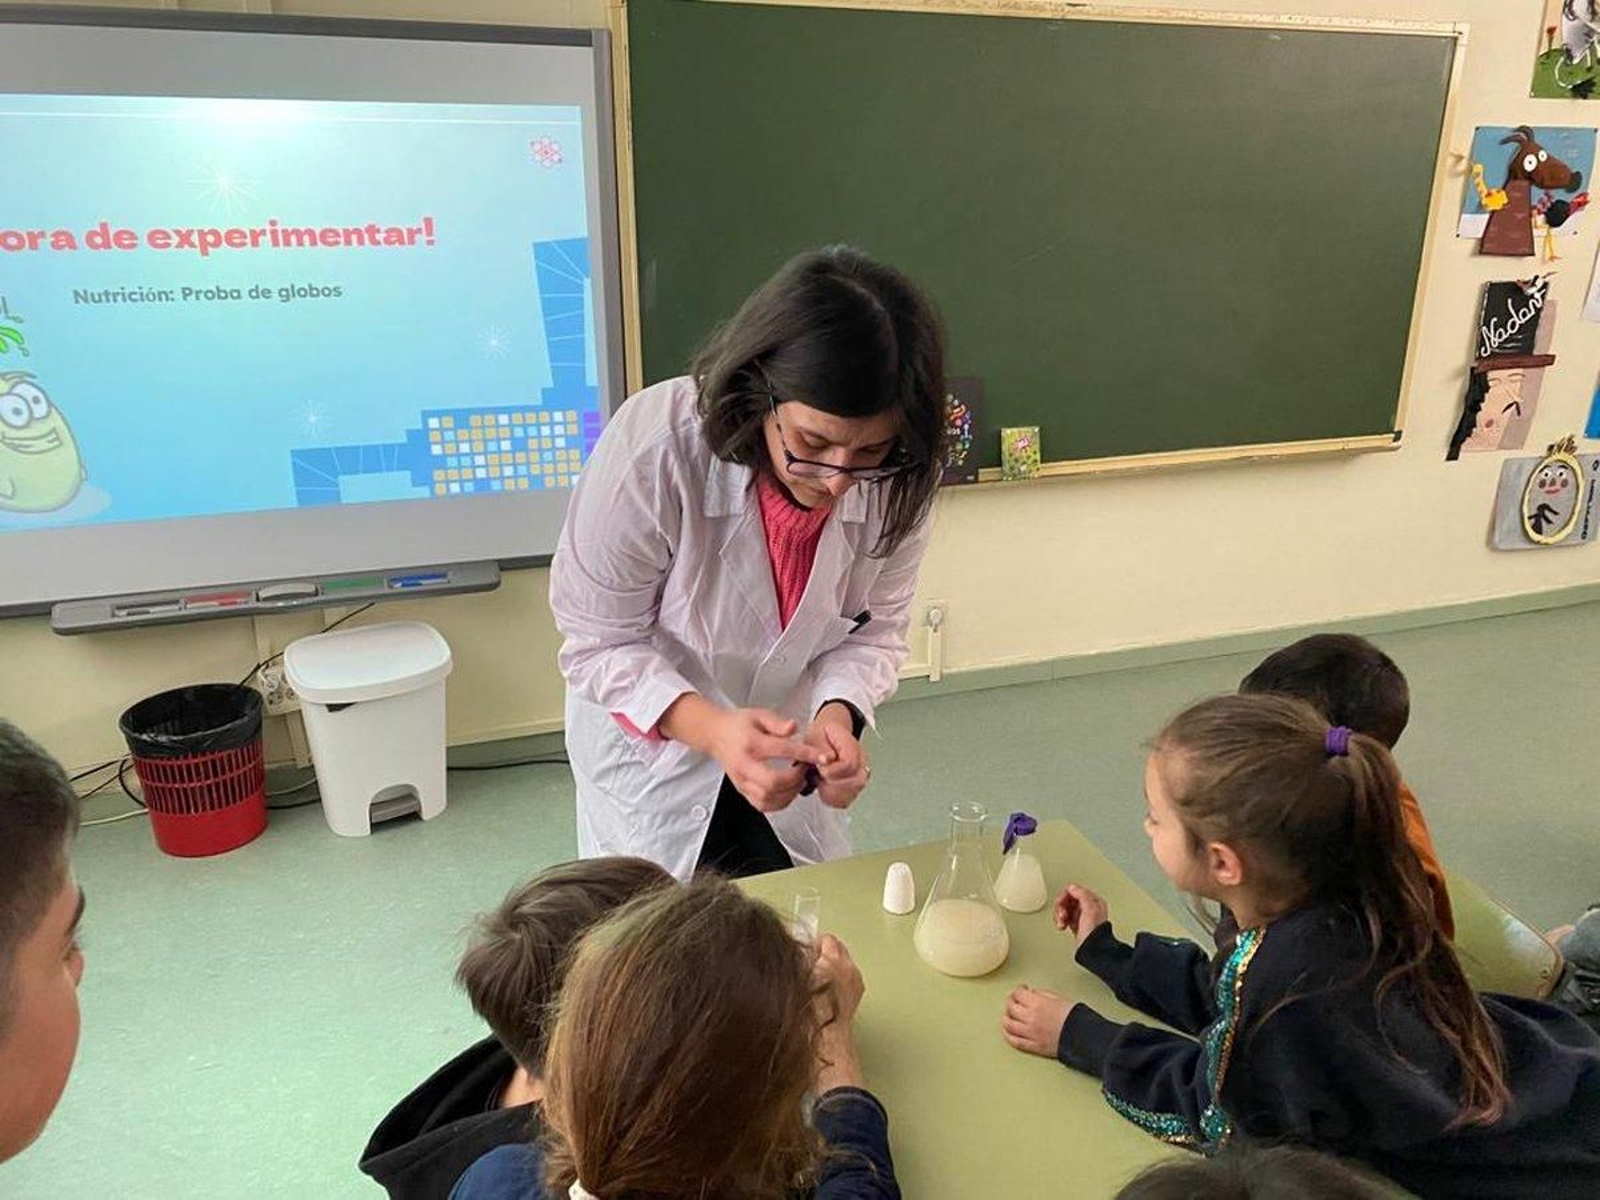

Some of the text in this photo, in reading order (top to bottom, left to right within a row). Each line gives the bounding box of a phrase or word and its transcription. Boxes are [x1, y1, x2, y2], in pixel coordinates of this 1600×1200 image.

[84, 221, 138, 251] de
[146, 216, 435, 257] experimentar!
[72, 282, 343, 305] Nutrición: Proba de globos
